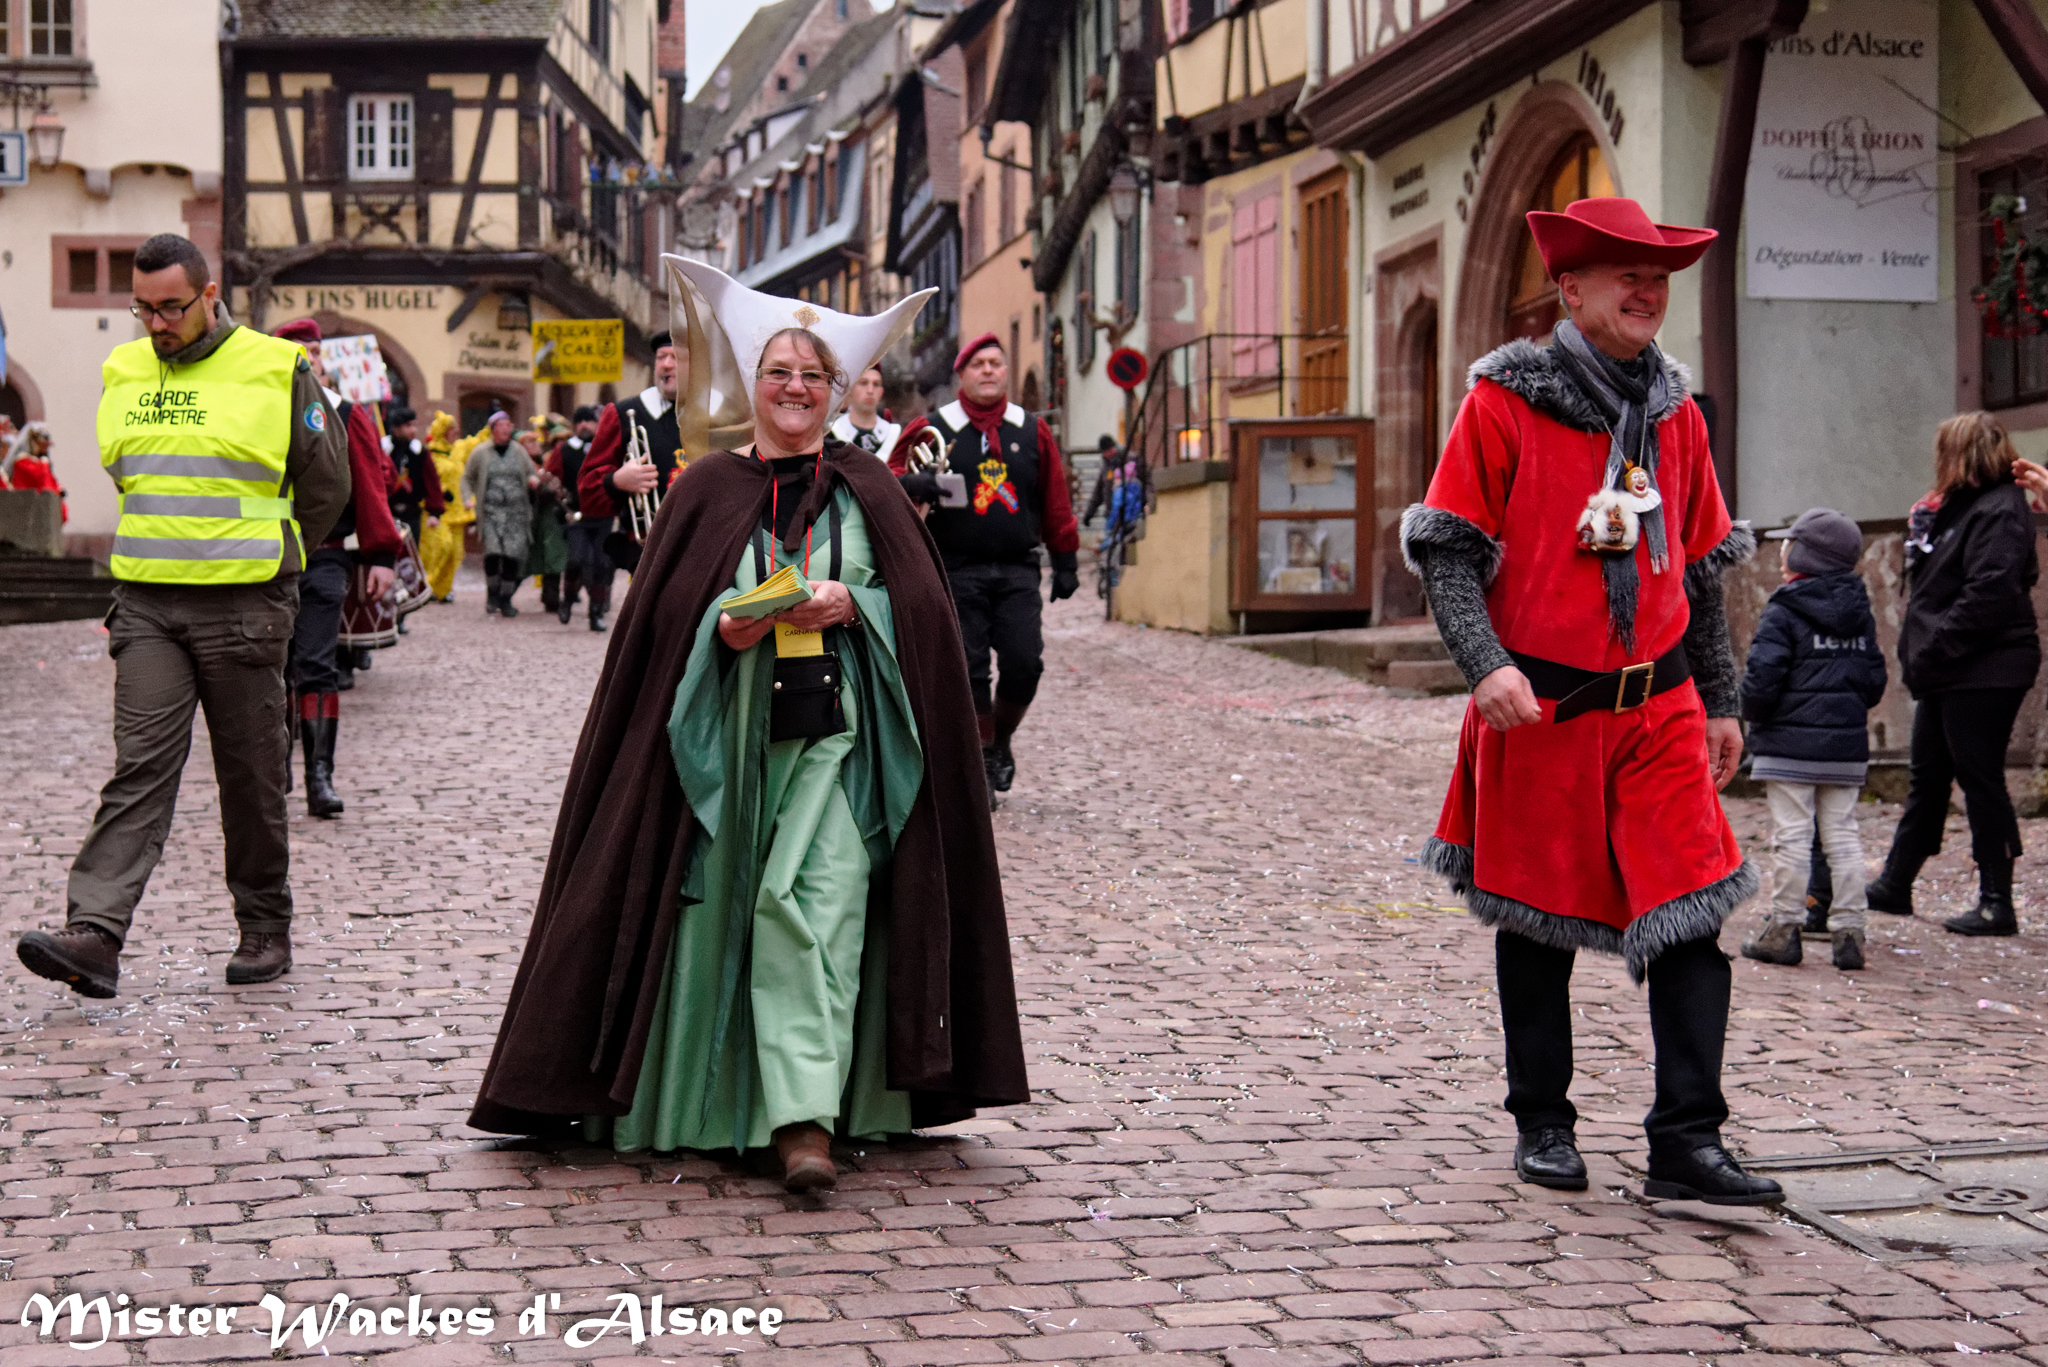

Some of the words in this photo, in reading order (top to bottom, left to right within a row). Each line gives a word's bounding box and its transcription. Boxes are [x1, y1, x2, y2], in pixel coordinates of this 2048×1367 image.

[1768, 36, 1814, 55] ins
[1822, 29, 1924, 58] d'Alsace
[1861, 132, 1925, 151] IRION
[1755, 246, 1864, 271] Dégustation
[1881, 249, 1931, 268] Vente
[306, 289, 355, 310] FINS
[138, 390, 199, 408] GARDE
[125, 410, 208, 427] CHAMPETRE
